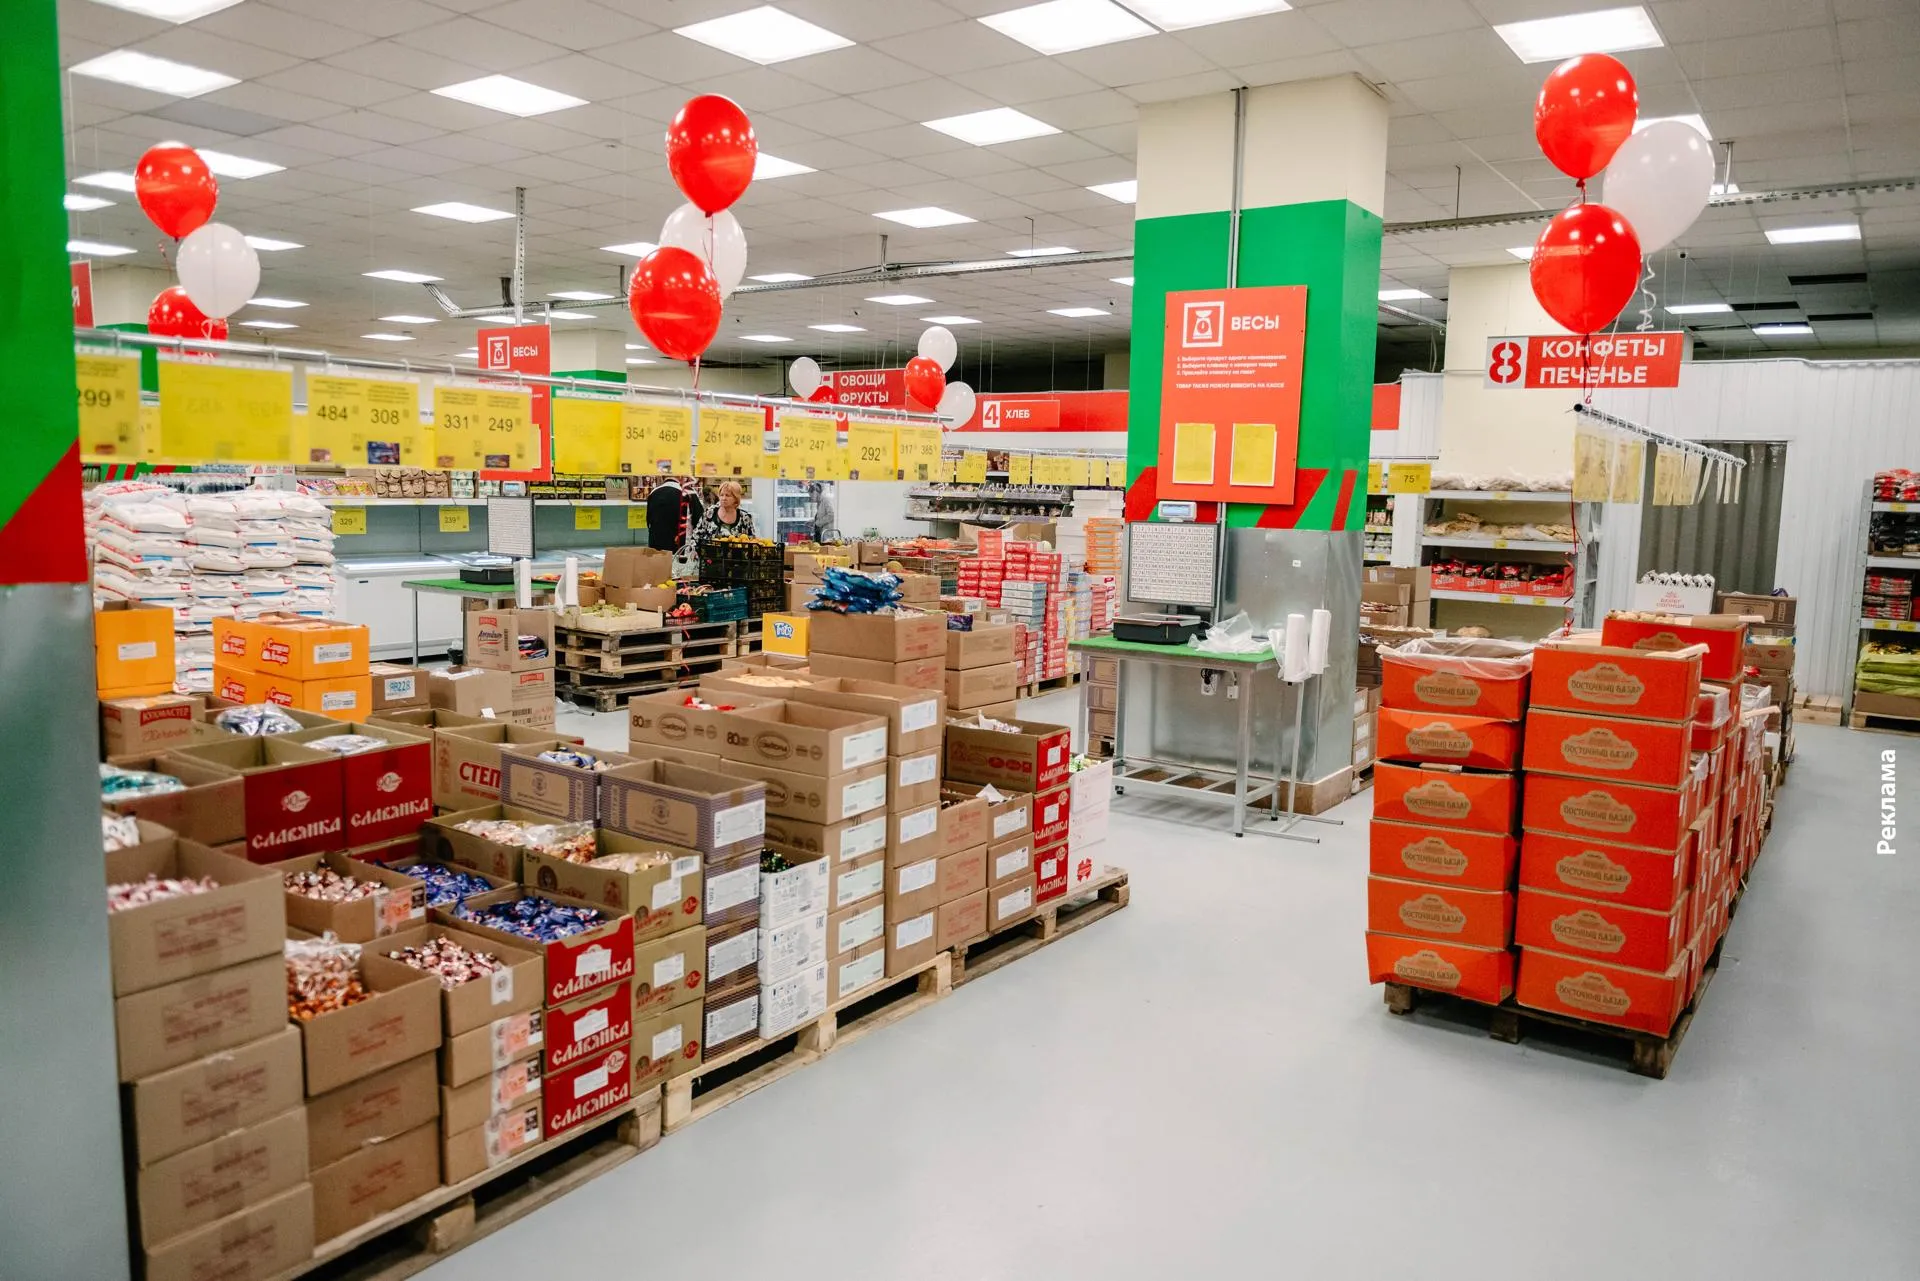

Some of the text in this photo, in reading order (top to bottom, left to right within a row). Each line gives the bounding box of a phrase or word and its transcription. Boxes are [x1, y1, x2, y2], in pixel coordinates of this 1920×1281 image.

[1231, 315, 1279, 331] ВЕСЫ
[513, 346, 538, 357] ВЕСЫ
[1541, 338, 1665, 358] КОНФЕТЫ
[1489, 342, 1522, 383] 8
[840, 373, 886, 388] ОВОЩИ
[1539, 365, 1648, 384] ПЕЧЕНЬЕ
[839, 391, 889, 404] ФРУКТЫ
[317, 405, 348, 421] 484
[370, 408, 400, 425] 308
[983, 401, 999, 428] 4
[1005, 408, 1030, 419] ХЛЕБ
[443, 414, 469, 429] 331
[488, 417, 513, 432] 249
[625, 427, 645, 440] 354
[658, 429, 678, 443] 469
[704, 430, 722, 443] 261
[734, 433, 751, 446] 248
[783, 436, 799, 449] 224
[809, 439, 825, 451] 247
[861, 446, 881, 462] 292
[1403, 475, 1415, 484] 75
[632, 715, 644, 728] 80
[727, 732, 739, 746] 80
[351, 798, 429, 827] СЛАВЯНКА
[252, 817, 341, 849] СЛАВЯНКА
[1036, 876, 1067, 895] ЛАВЯНКА
[551, 1083, 629, 1130] СЛАВЯНКА
